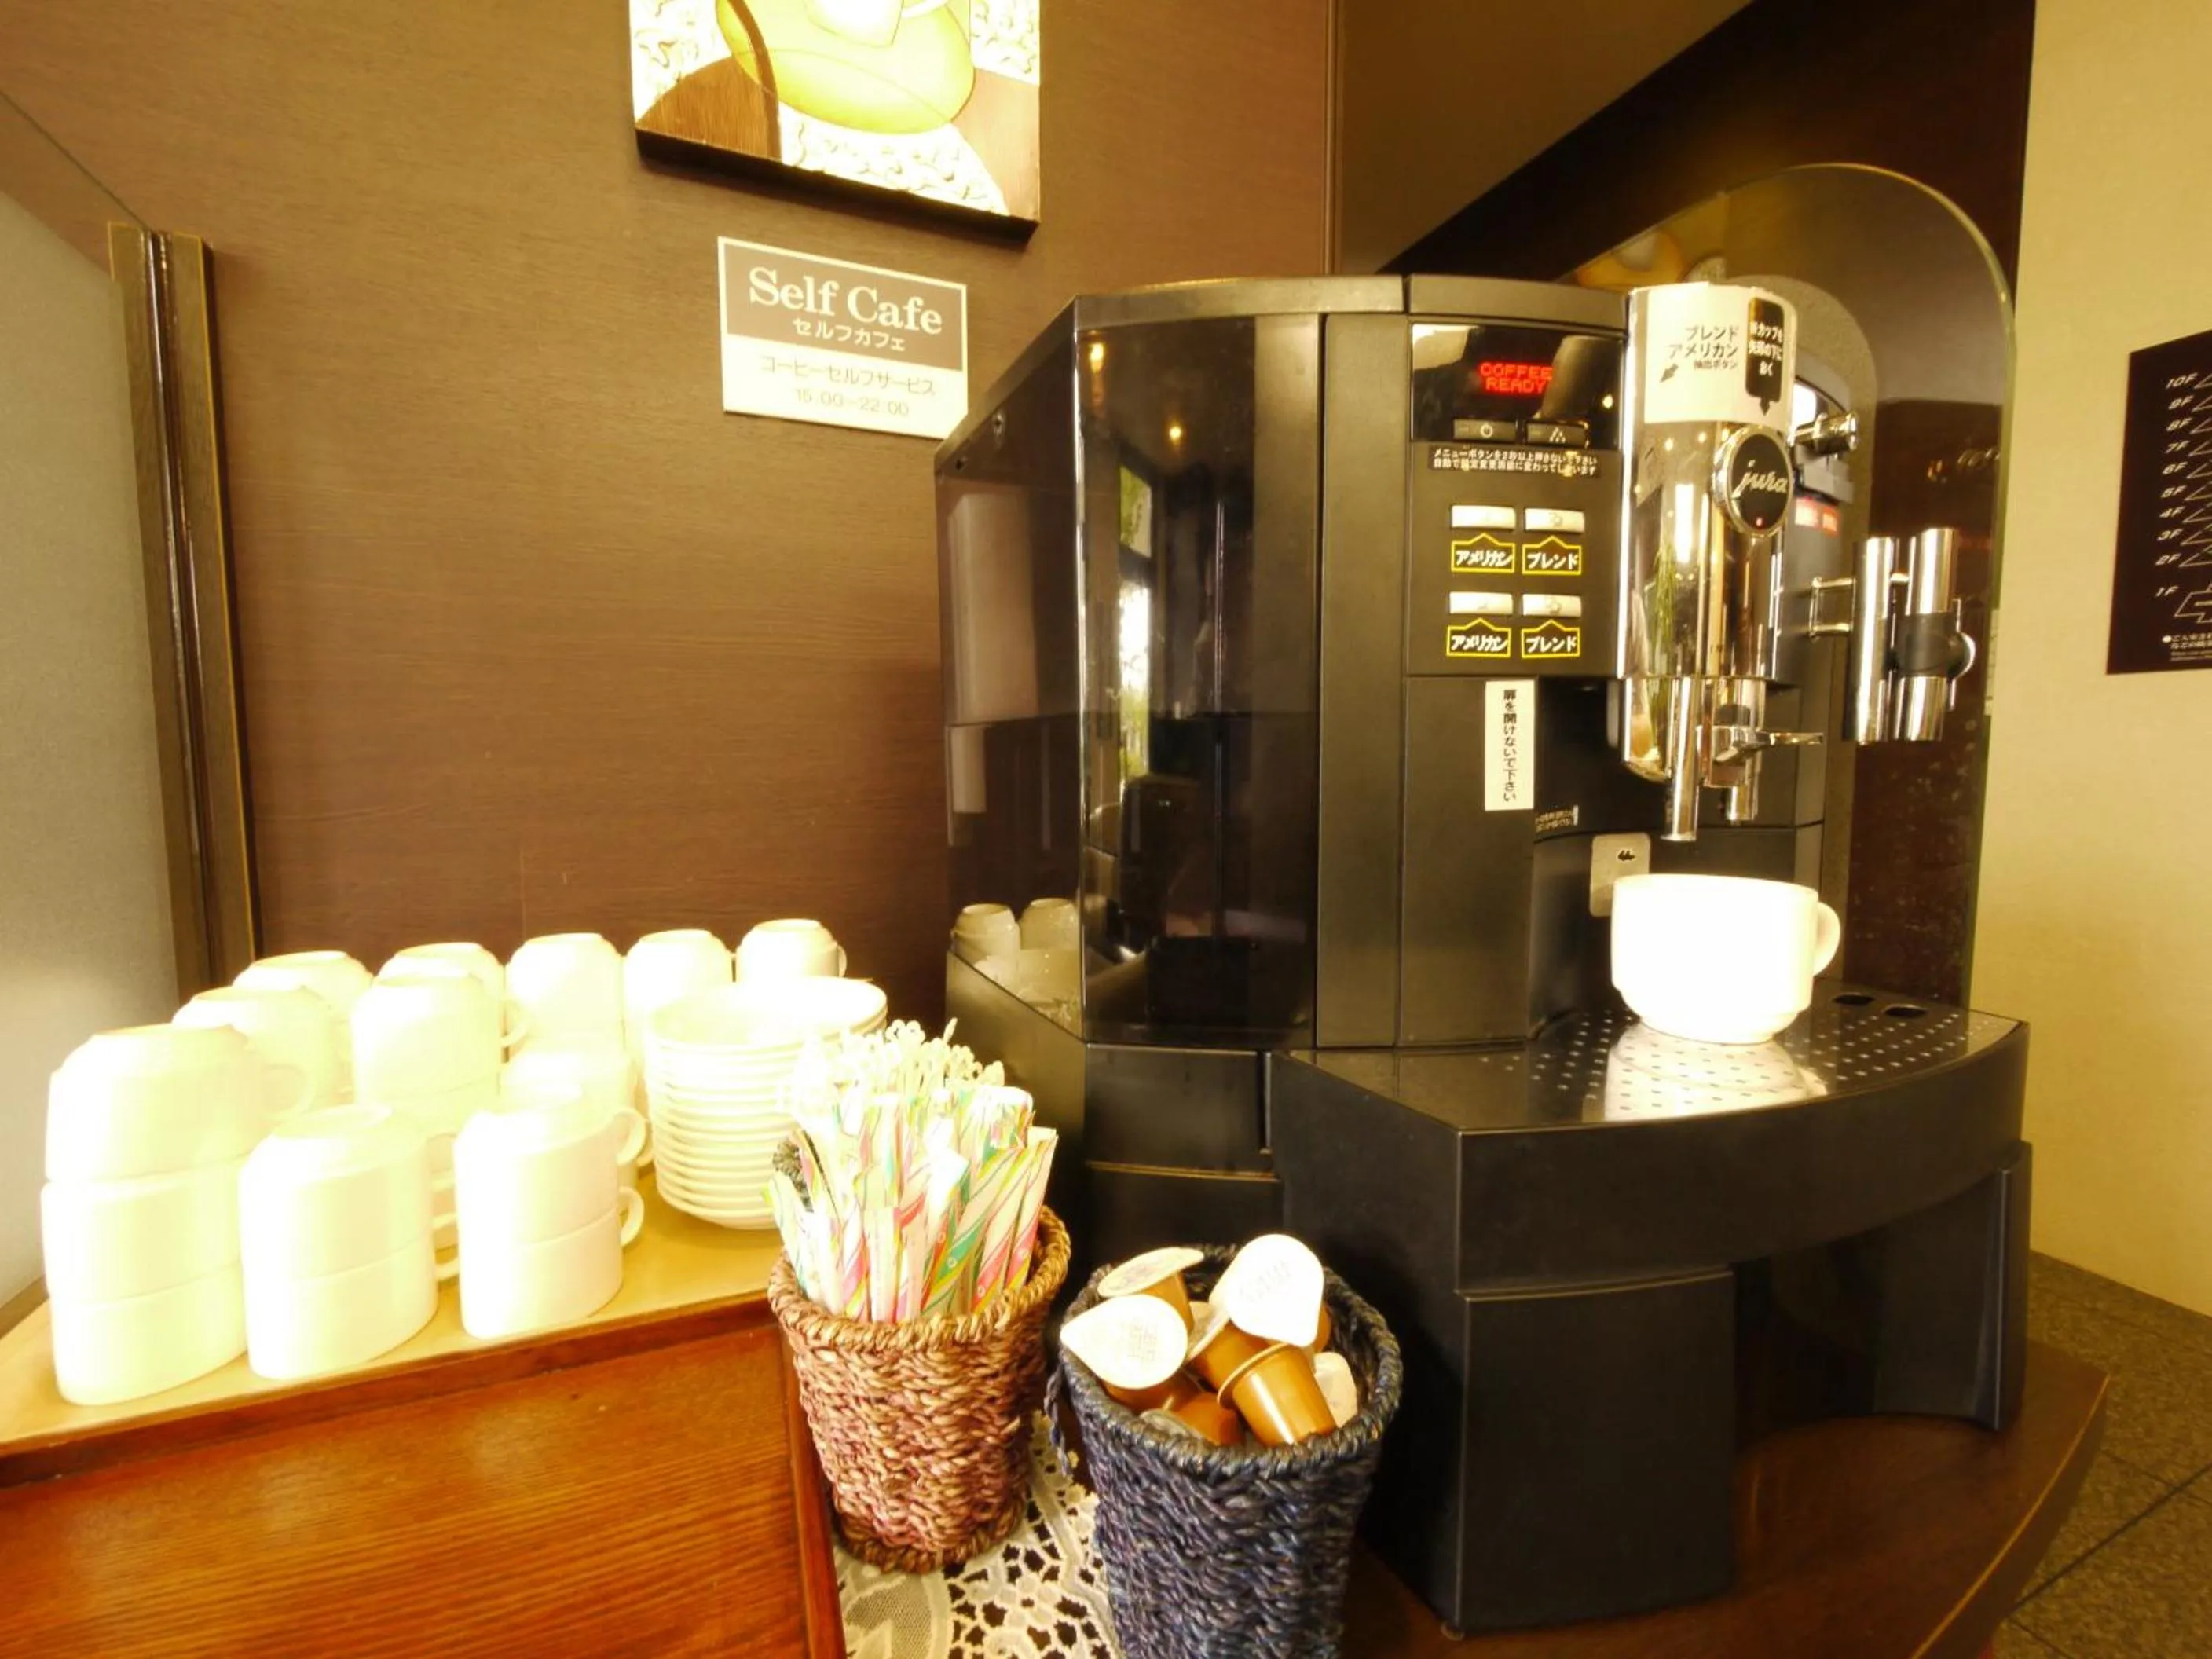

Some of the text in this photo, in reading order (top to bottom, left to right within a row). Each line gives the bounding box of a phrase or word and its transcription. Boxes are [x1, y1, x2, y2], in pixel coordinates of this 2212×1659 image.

[749, 266, 943, 335] Self Cafe
[792, 317, 906, 352] セルフカフェ
[1685, 324, 1739, 342] ブレンド
[1668, 342, 1738, 359] アメリカン
[1479, 362, 1553, 380] COFFEE
[1485, 377, 1547, 394] READY
[2166, 372, 2199, 389] 10F
[2165, 440, 2190, 454] 7F
[1731, 460, 1789, 499] jura
[2159, 506, 2185, 518] 4F
[2157, 529, 2183, 541] 3F
[1456, 549, 1513, 568] アメリカン
[1526, 551, 1579, 571] ブレンド
[2155, 553, 2181, 566] 2F
[2155, 585, 2179, 597] 1F
[1451, 634, 1509, 652] アメリカン
[1525, 635, 1578, 654] ブレンド
